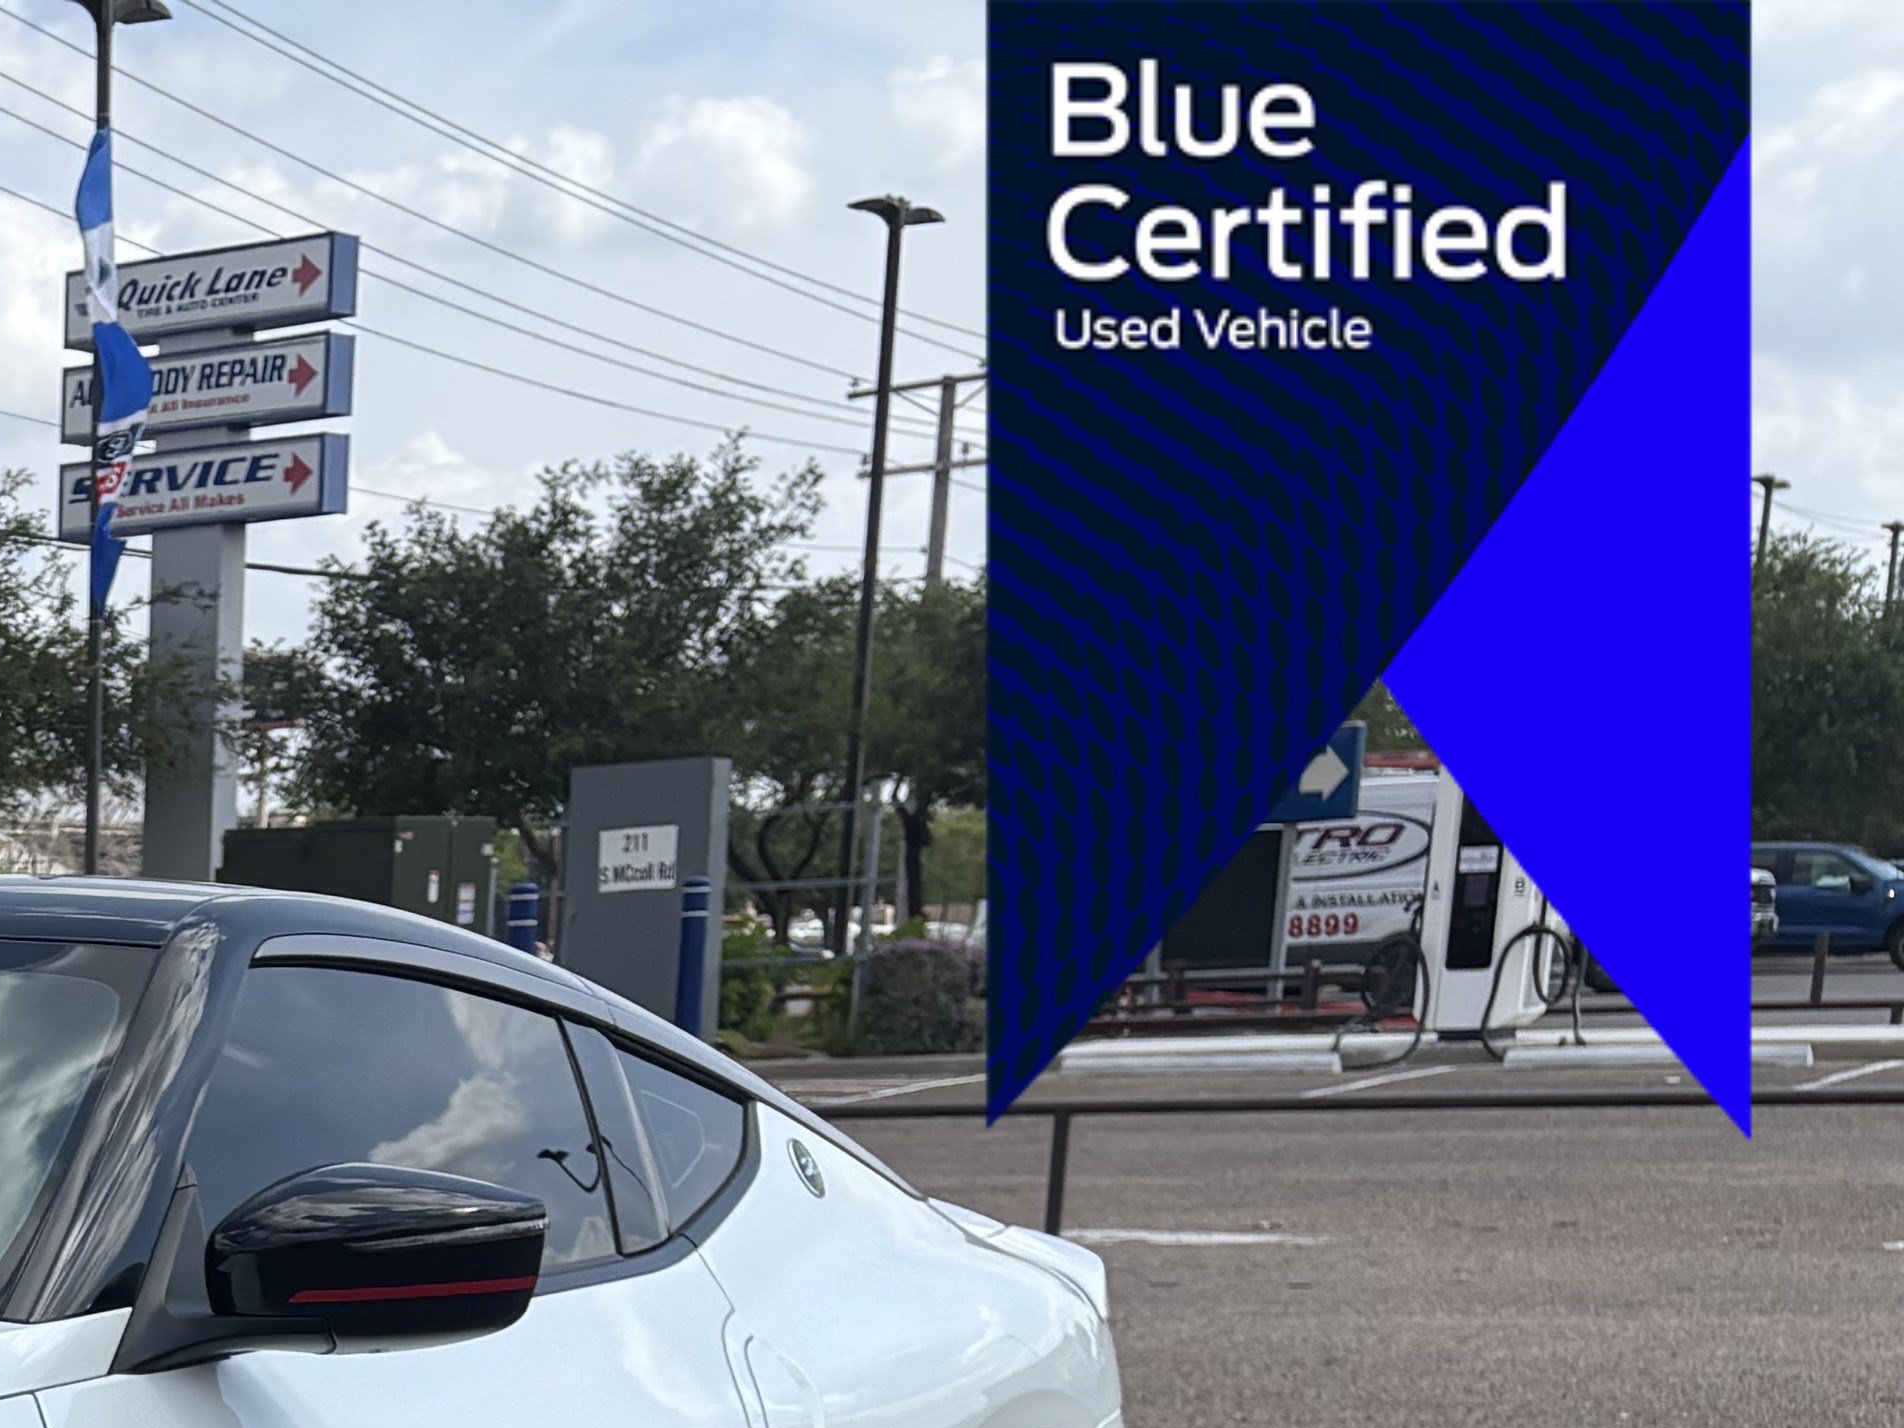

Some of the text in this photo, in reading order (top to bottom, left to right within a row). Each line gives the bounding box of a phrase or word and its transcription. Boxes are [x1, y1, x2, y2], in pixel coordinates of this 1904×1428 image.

[117, 271, 203, 311] Quick
[205, 265, 289, 296] Lane
[198, 354, 286, 391] REPAIR
[69, 453, 280, 504] SRVICE
